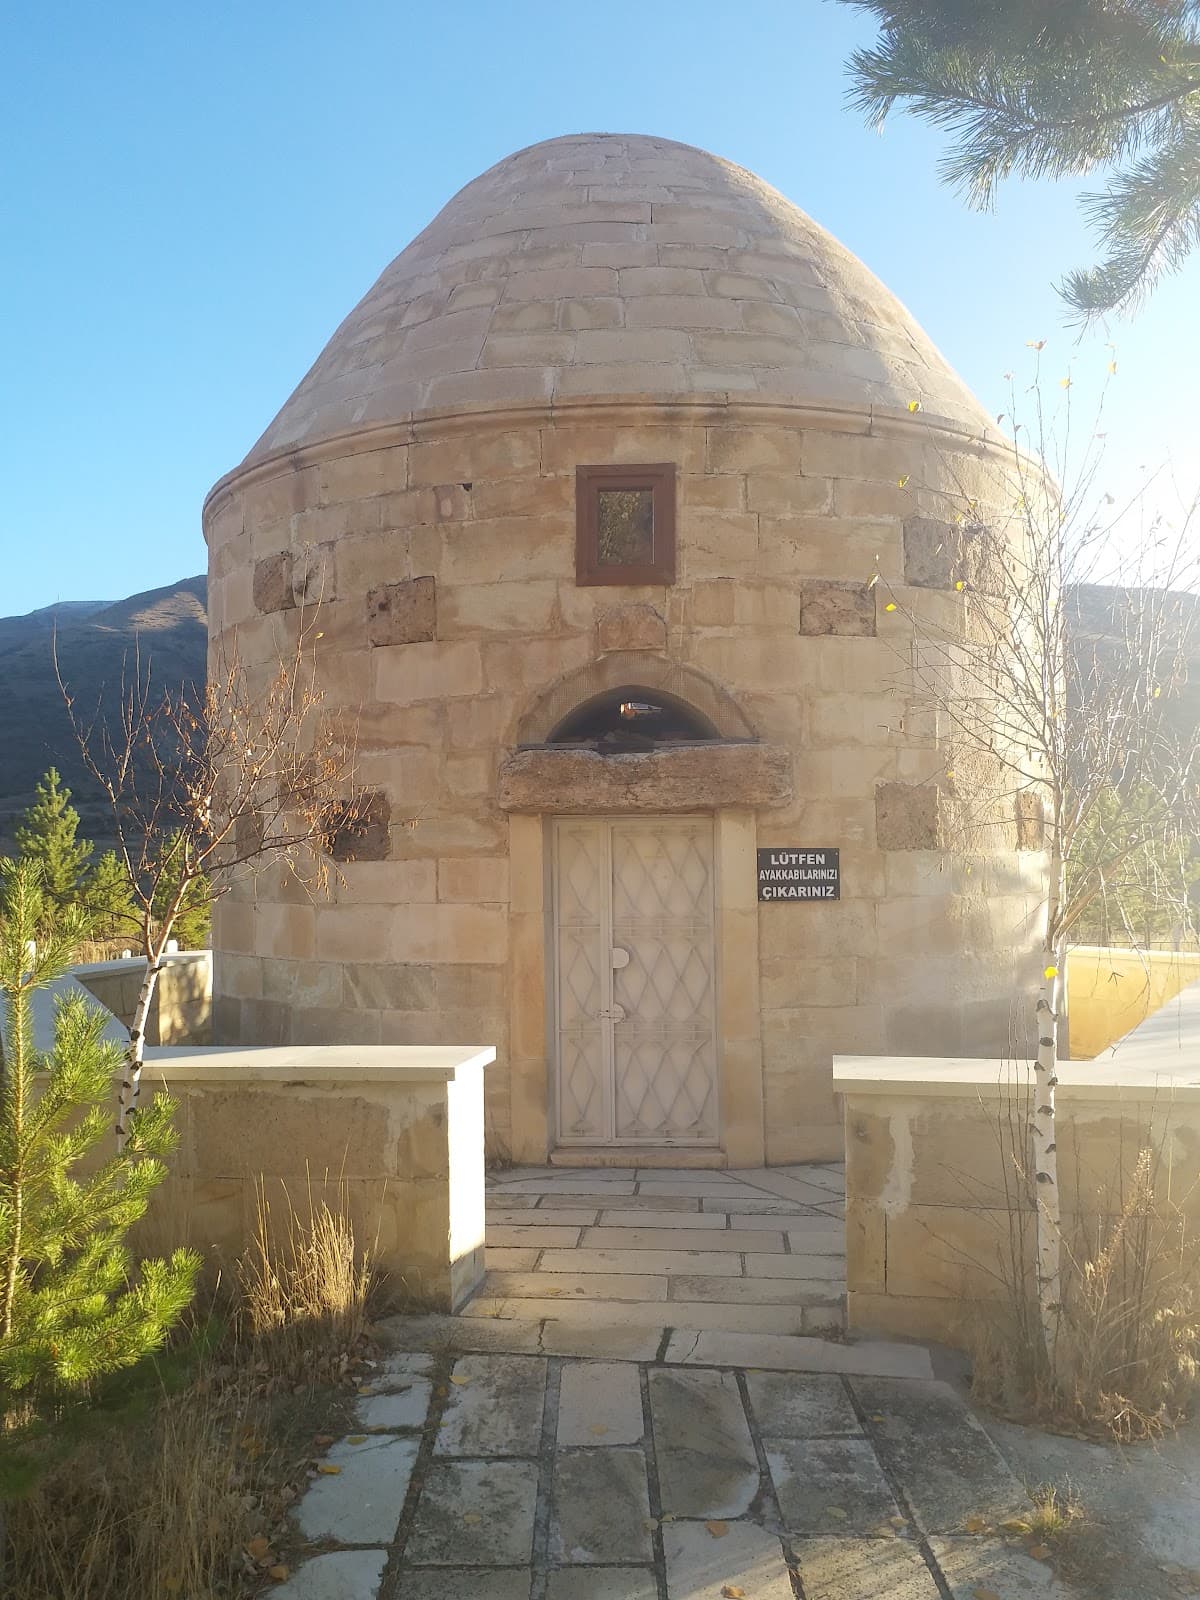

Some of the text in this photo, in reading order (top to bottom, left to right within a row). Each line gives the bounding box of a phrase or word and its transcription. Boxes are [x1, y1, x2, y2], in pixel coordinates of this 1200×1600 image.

[771, 852, 825, 865] LÜTFEN
[759, 869, 837, 880] AYAKKABILARINIZI
[762, 886, 835, 900] ÇIKARINIZ
